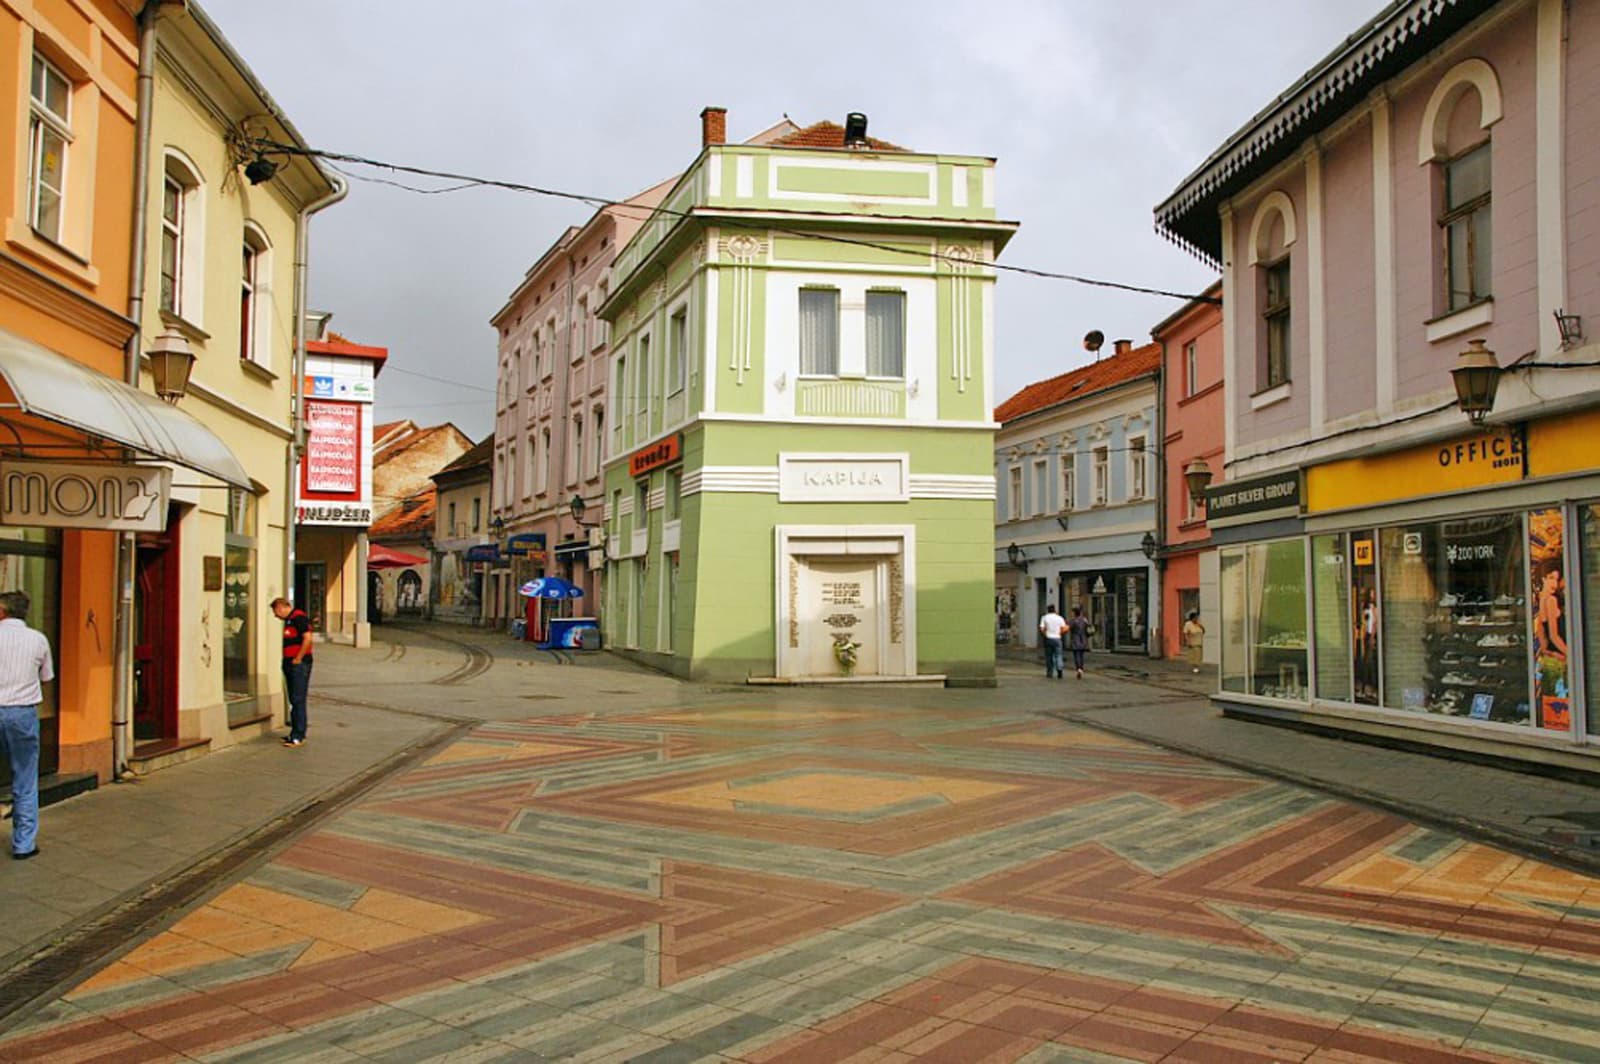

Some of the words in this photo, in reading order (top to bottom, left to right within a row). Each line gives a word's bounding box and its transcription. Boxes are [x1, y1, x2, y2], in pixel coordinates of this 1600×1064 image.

[1439, 433, 1522, 467] OFFICE
[804, 471, 882, 487] KAPIJA
[1211, 494, 1237, 511] PLANET
[1238, 487, 1265, 504] SILVER
[1265, 481, 1297, 499] GROUP
[1458, 546, 1473, 561] ZOO
